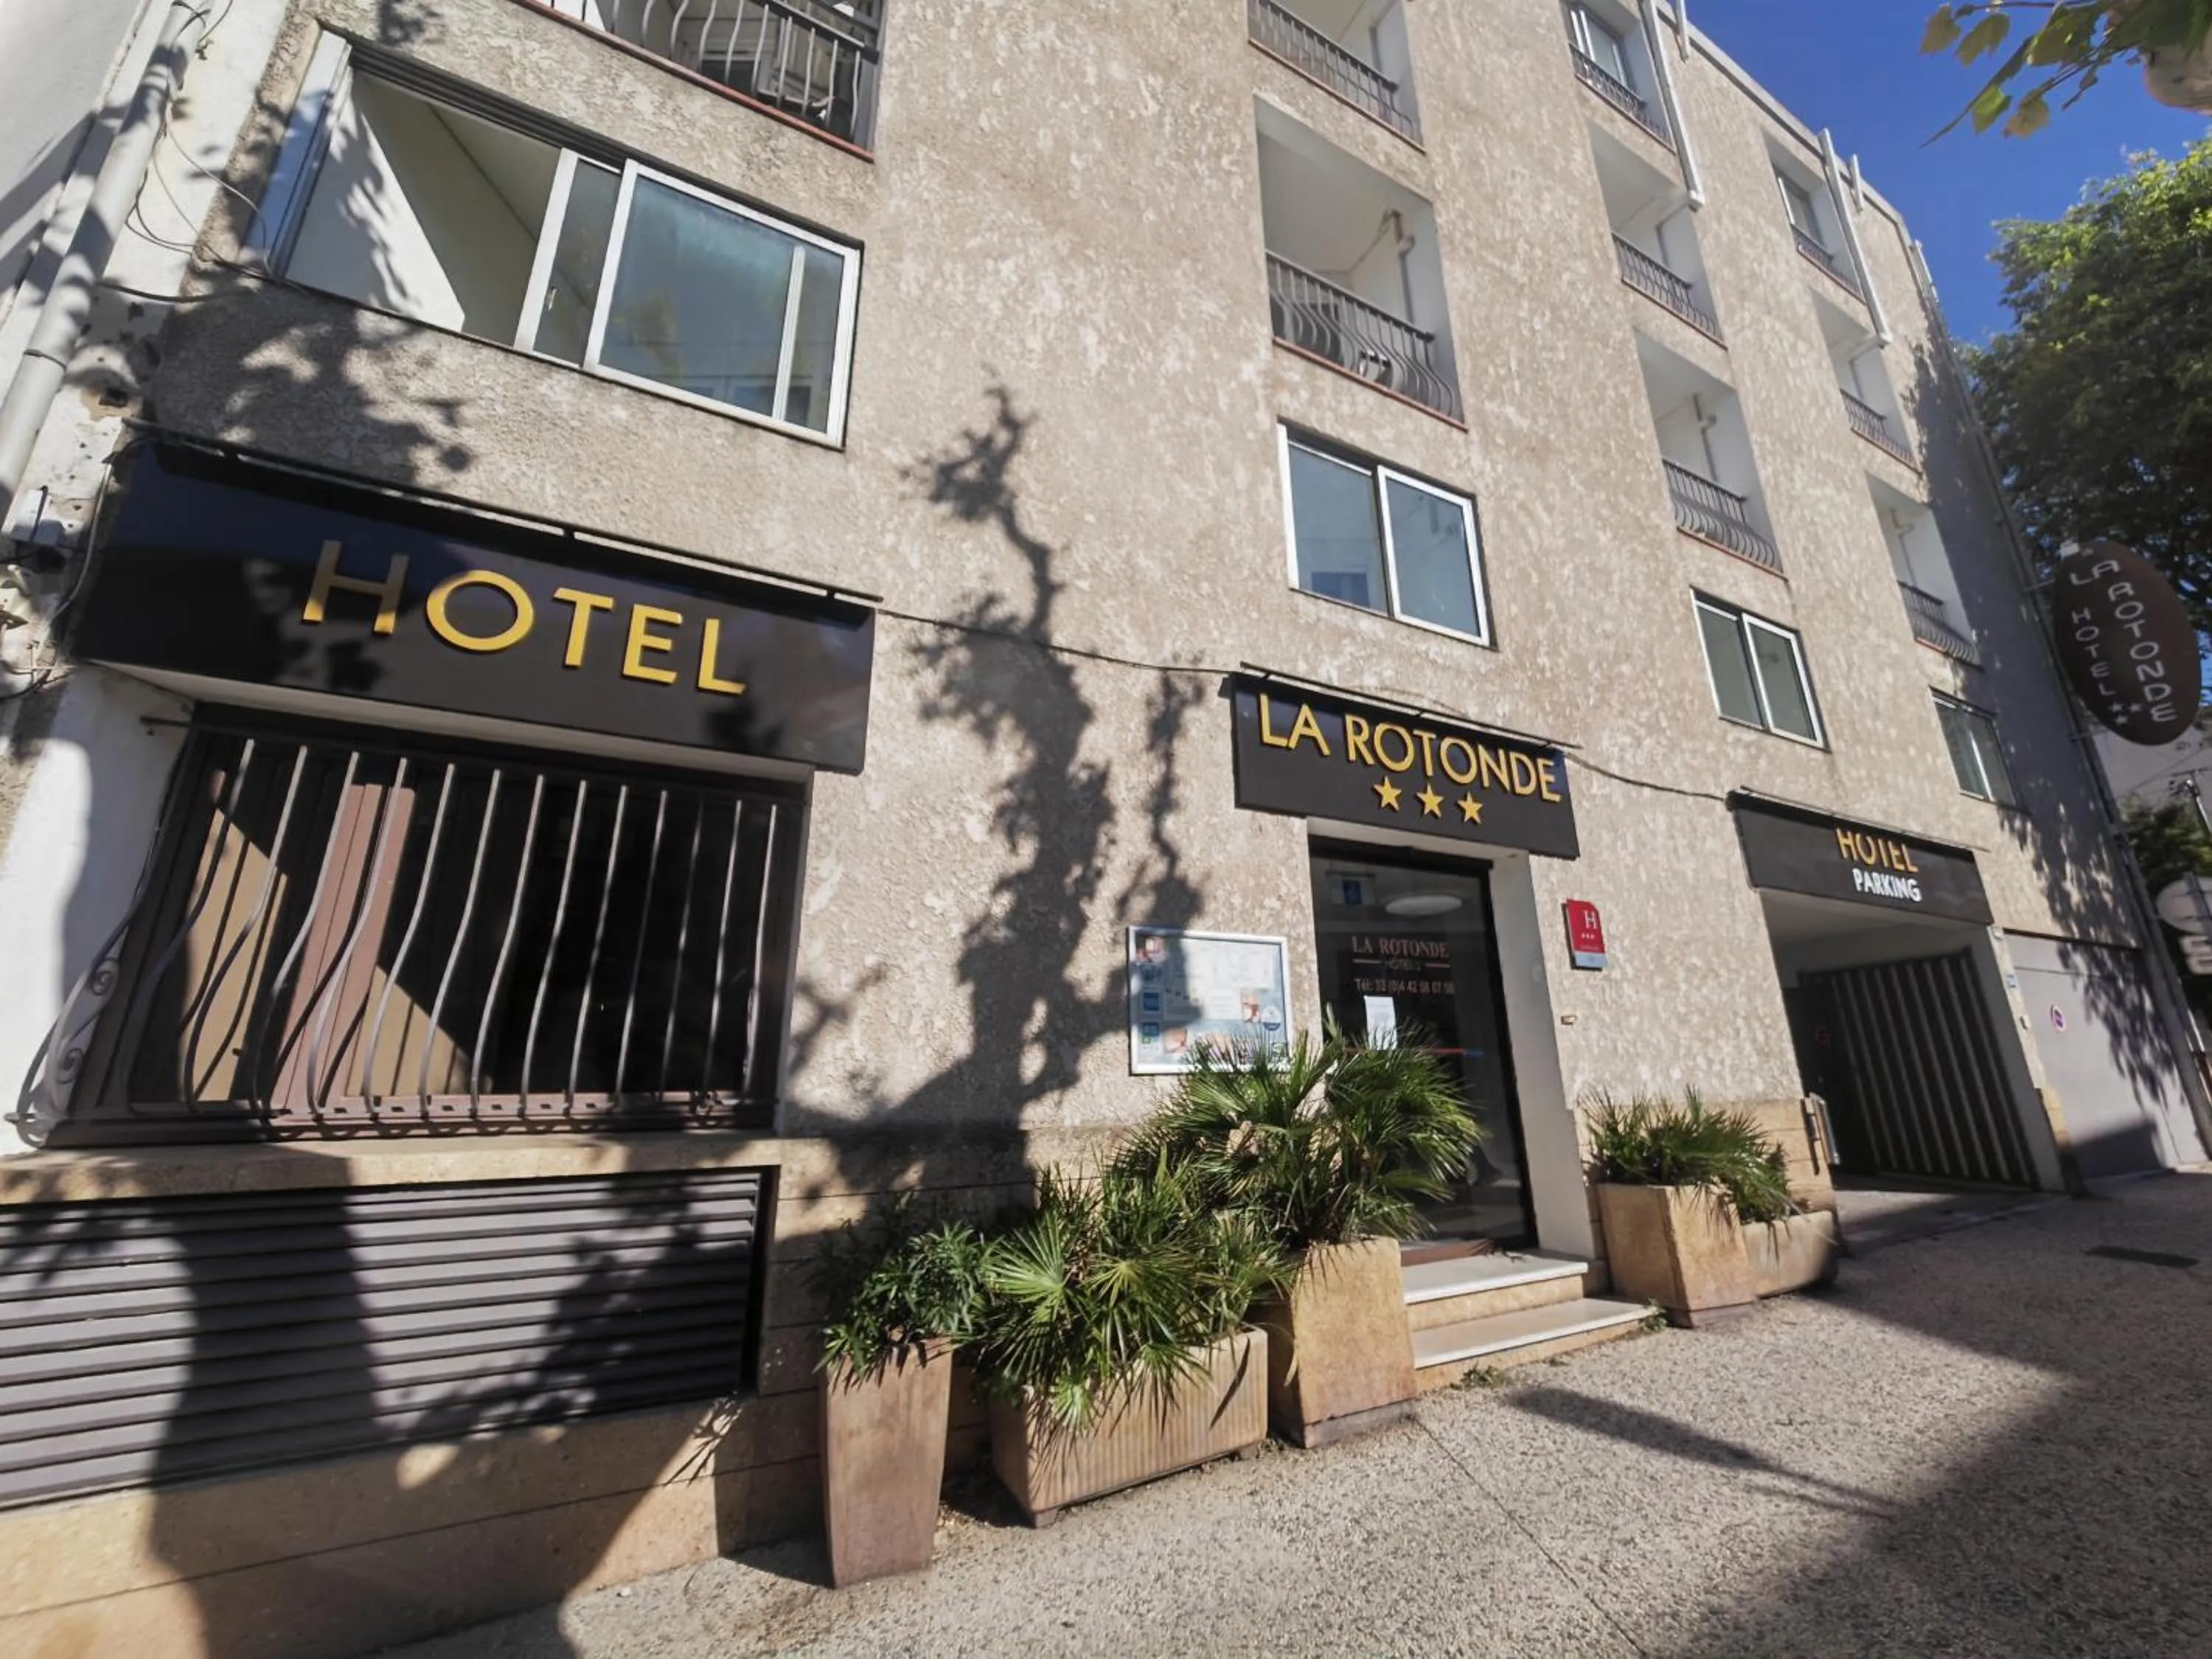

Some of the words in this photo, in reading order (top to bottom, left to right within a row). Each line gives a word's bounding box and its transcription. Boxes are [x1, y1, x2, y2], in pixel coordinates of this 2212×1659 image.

[302, 540, 746, 695] HOTEL
[2070, 560, 2121, 585] LA
[2107, 582, 2179, 722] ROTONDE
[2071, 608, 2116, 696] HOTEL
[1259, 693, 1330, 757] LA
[1344, 713, 1562, 802] ROTONDE
[1836, 827, 1919, 873] HOTEL
[1852, 868, 1922, 902] PARKING
[1352, 936, 1373, 953] LA
[1380, 937, 1450, 959] ROTONDE
